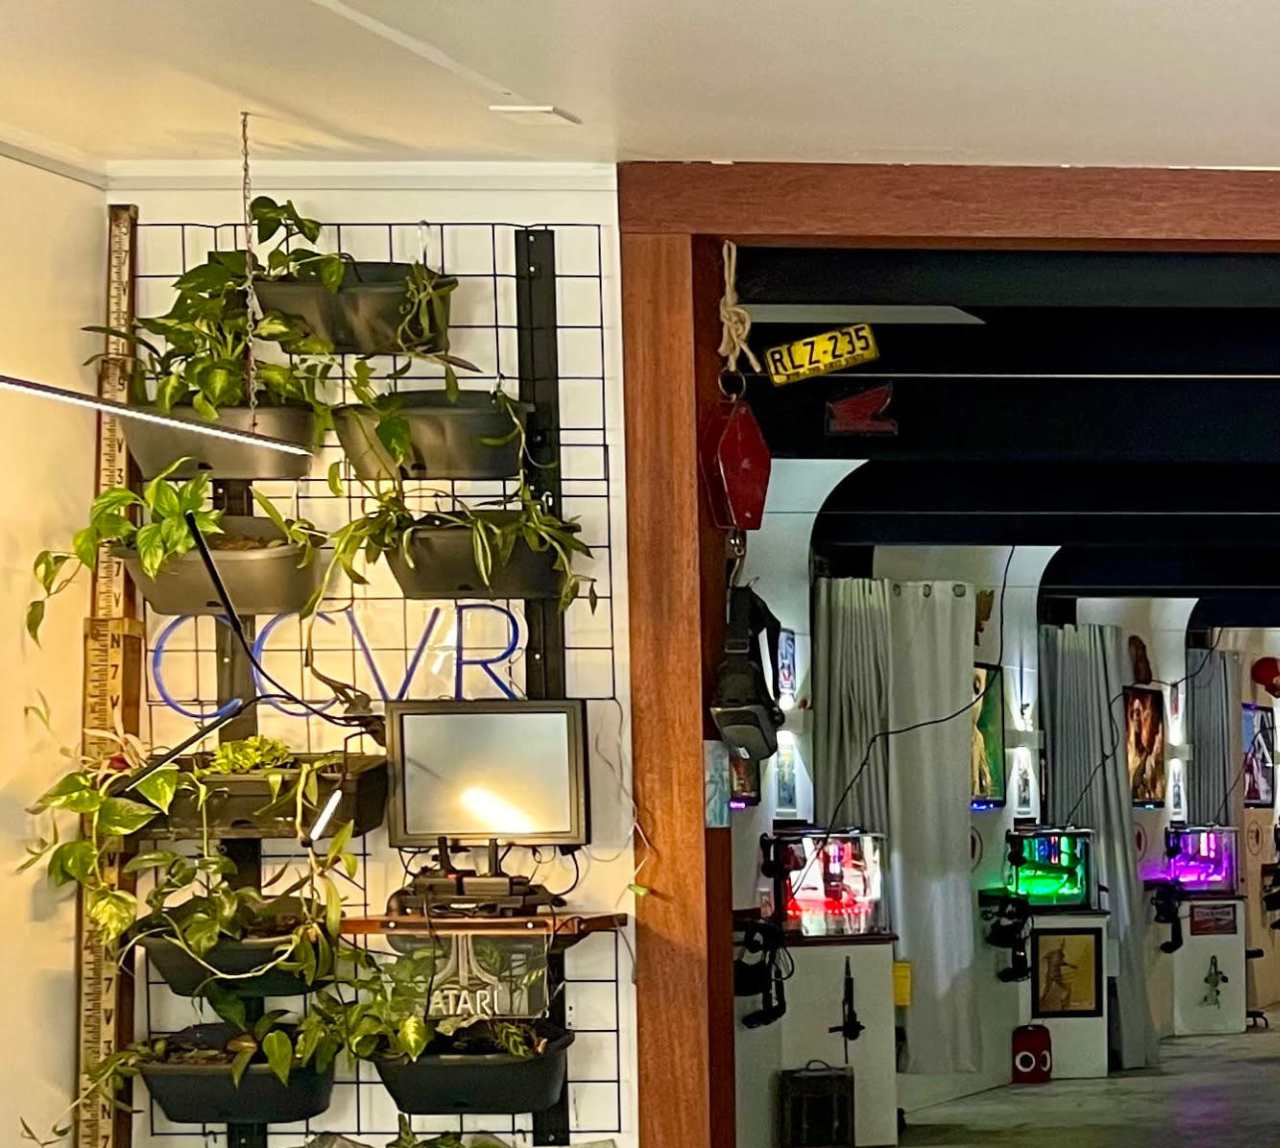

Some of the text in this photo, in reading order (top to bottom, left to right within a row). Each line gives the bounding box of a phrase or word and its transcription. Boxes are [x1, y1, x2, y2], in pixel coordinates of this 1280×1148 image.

[113, 561, 122, 577] 7
[110, 633, 120, 649] N
[152, 604, 520, 718] CCVR
[110, 664, 119, 680] 7
[103, 977, 113, 993] 7
[429, 989, 501, 1016] ATARI
[103, 1008, 113, 1025] V
[101, 1103, 112, 1120] N
